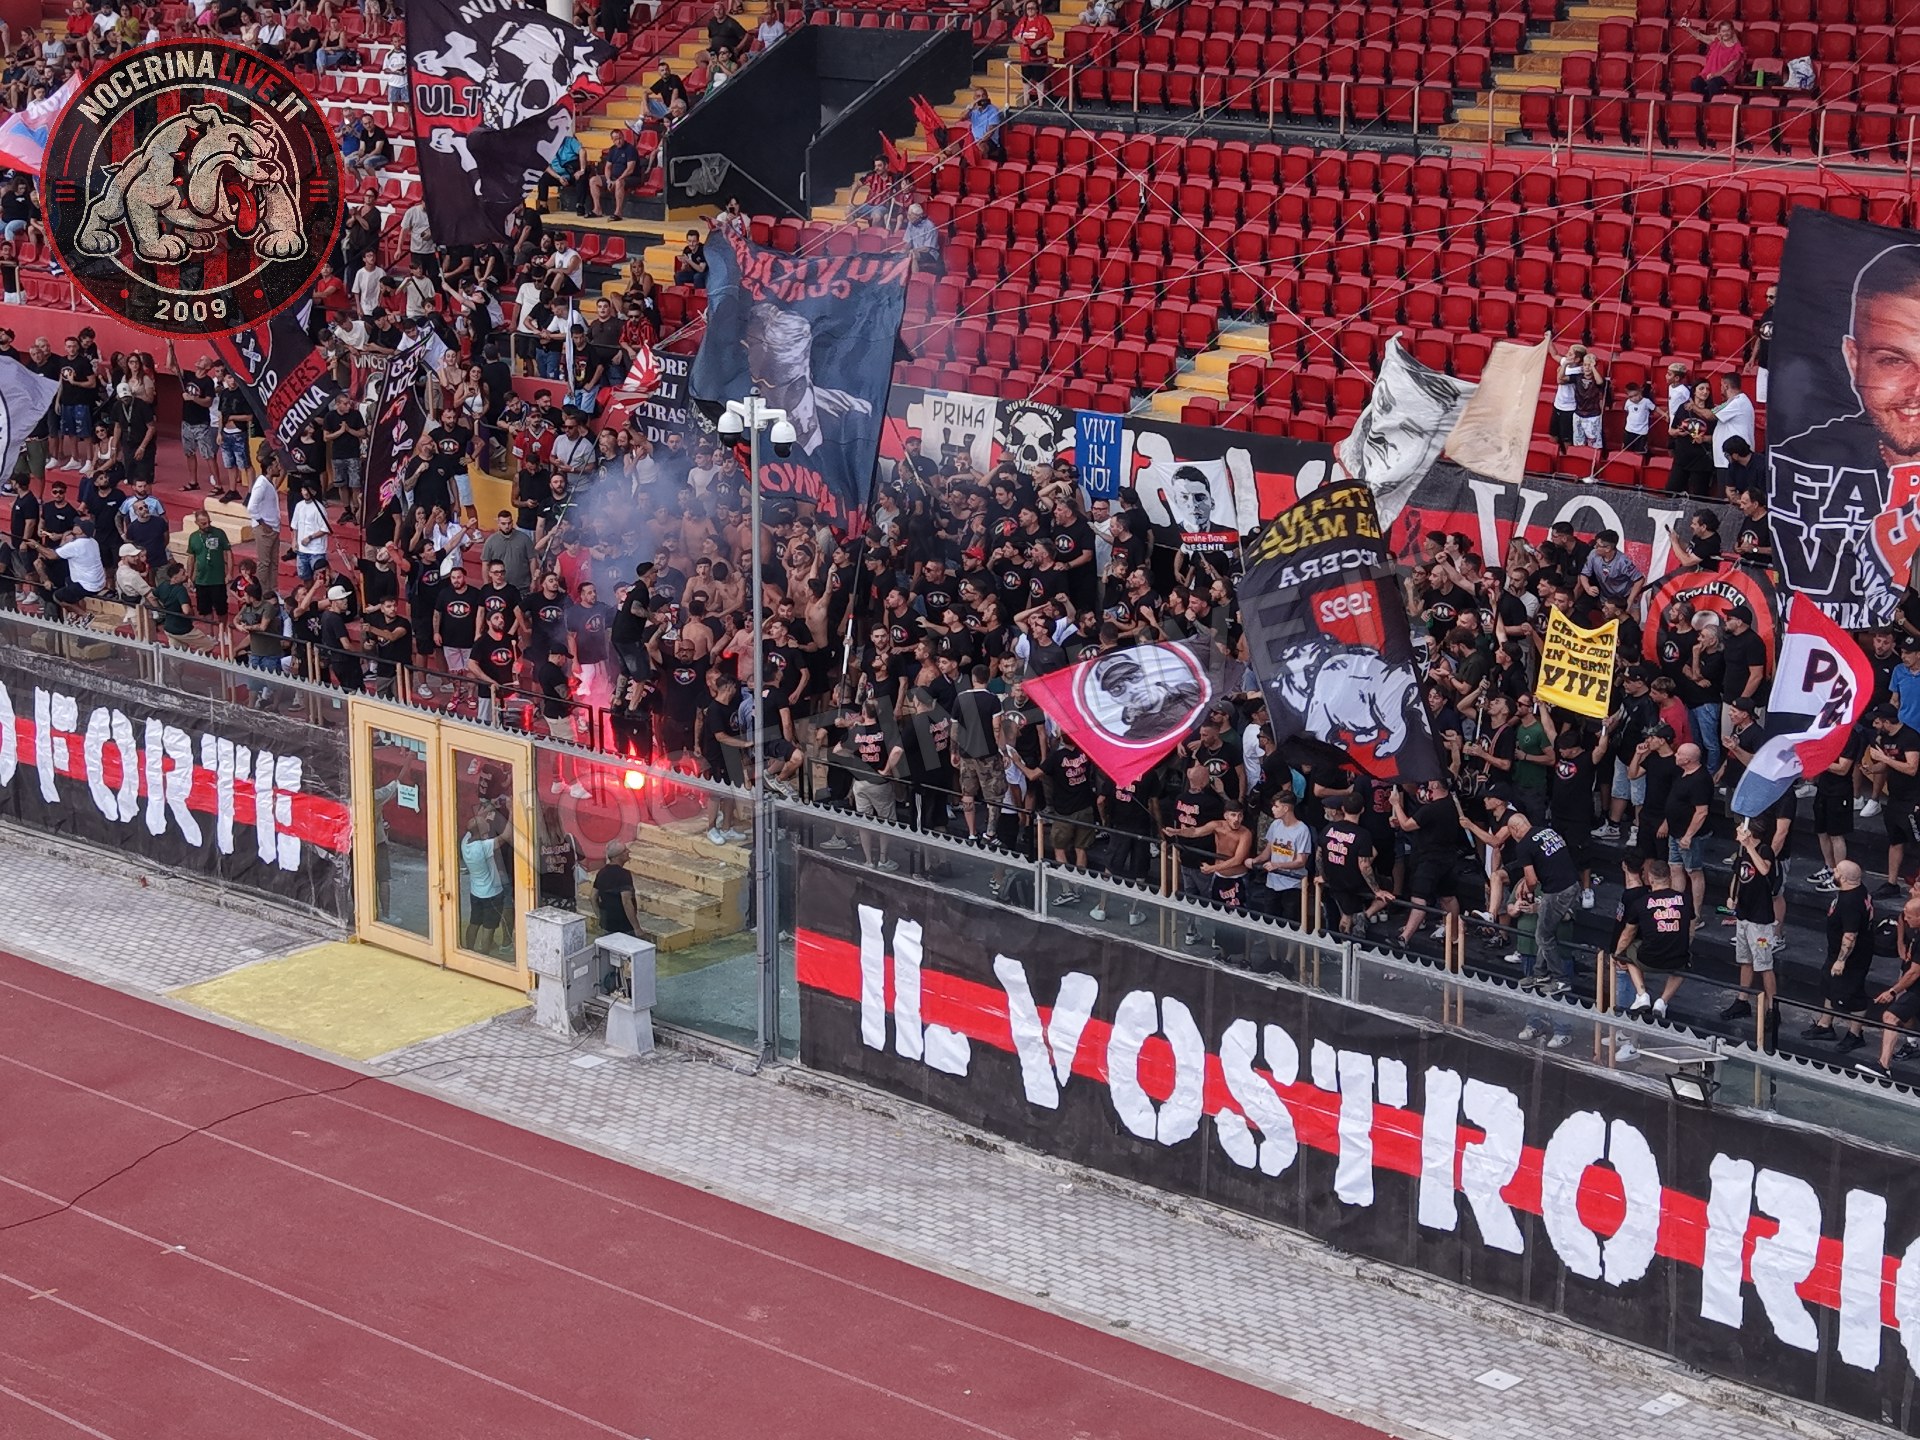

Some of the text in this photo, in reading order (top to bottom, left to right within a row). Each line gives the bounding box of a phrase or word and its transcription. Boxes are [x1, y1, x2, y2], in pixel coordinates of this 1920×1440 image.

[932, 400, 986, 428] PRIMA
[1082, 417, 1115, 444] VIVI
[1088, 444, 1106, 467] IN
[1083, 468, 1111, 492] NOI
[1545, 648, 1565, 661] IN
[1543, 664, 1610, 702] VIVE
[33, 686, 302, 872] FORTE
[1647, 895, 1684, 909] Angeli
[1654, 908, 1681, 920] della
[1657, 920, 1680, 932] Sud
[857, 903, 971, 1077] IL
[993, 952, 1662, 1287] VOSTRO
